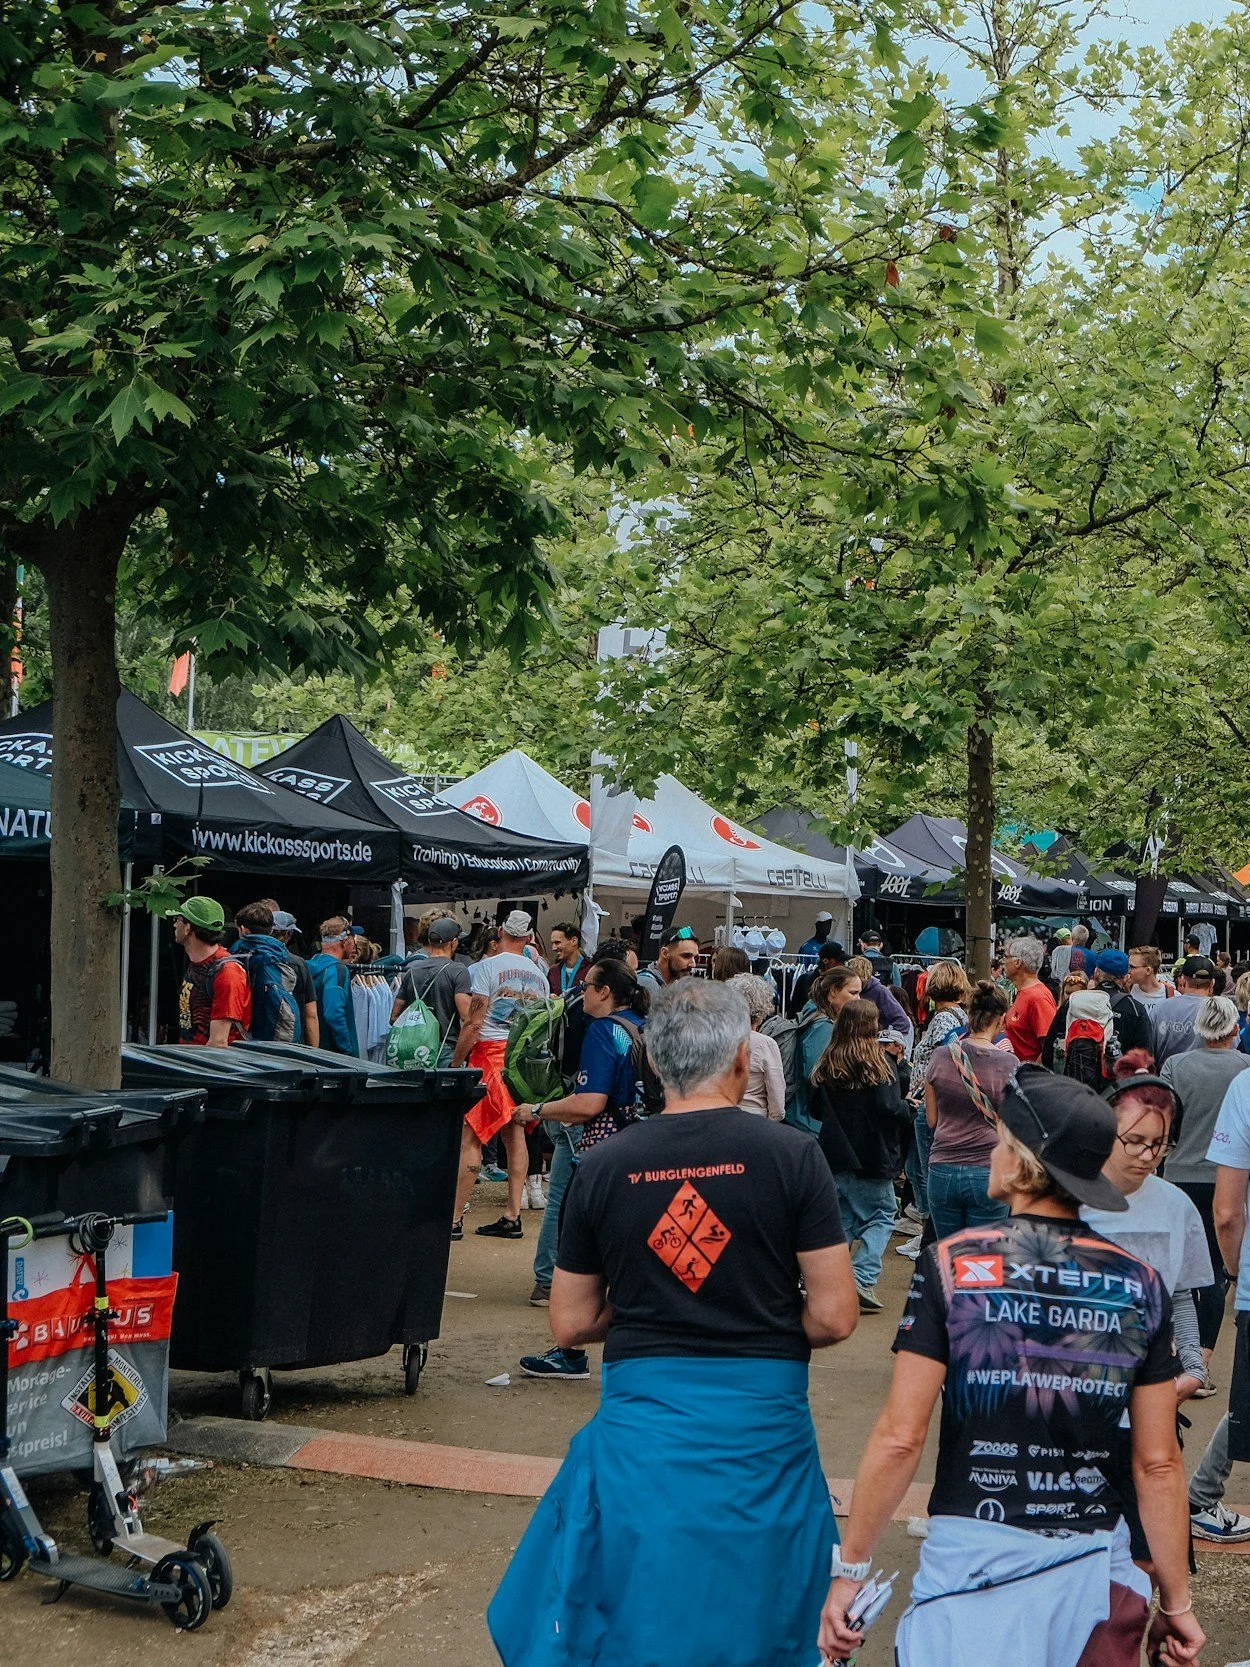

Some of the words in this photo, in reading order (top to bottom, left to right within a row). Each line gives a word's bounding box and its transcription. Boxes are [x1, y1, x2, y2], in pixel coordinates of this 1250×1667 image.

[192, 822, 373, 863] www.kickasssports.de
[412, 844, 459, 870] Training
[467, 853, 520, 871] Education
[525, 857, 581, 874] Community
[628, 1172, 642, 1184] TV
[645, 1163, 745, 1183] BURGLENGENFELD
[1009, 1262, 1144, 1298] XTERRA
[34, 1305, 152, 1343] BAUUS
[985, 1300, 1041, 1325] LAKE
[1048, 1305, 1122, 1335] GARDA
[969, 1440, 1018, 1457] ZOGGS
[969, 1471, 1018, 1486] MANIVA
